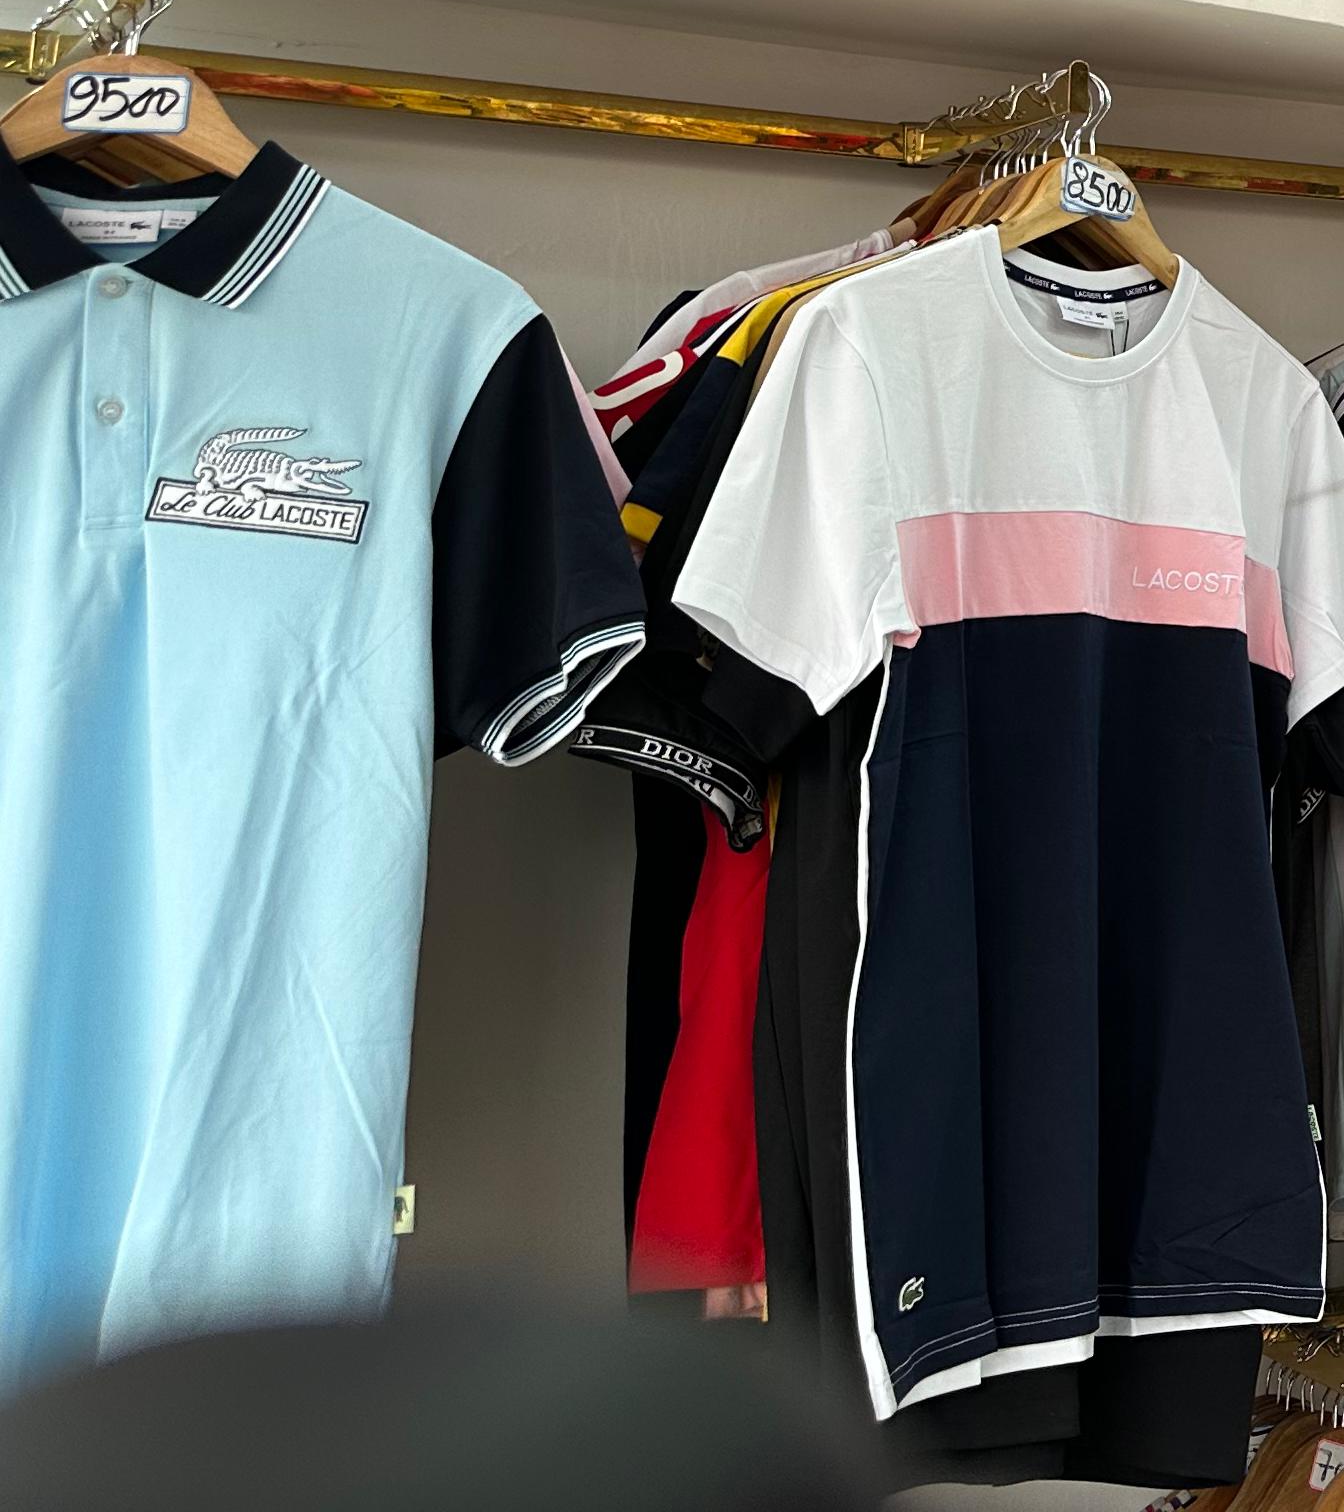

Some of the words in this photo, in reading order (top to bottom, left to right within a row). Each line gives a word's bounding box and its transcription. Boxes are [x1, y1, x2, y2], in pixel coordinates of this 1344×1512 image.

[62, 75, 180, 122] 9500
[1067, 162, 1131, 213] 8500
[160, 491, 198, 513] Le
[203, 494, 256, 521] Club
[259, 502, 356, 531] LACOSTE
[640, 738, 714, 776] DIOR
